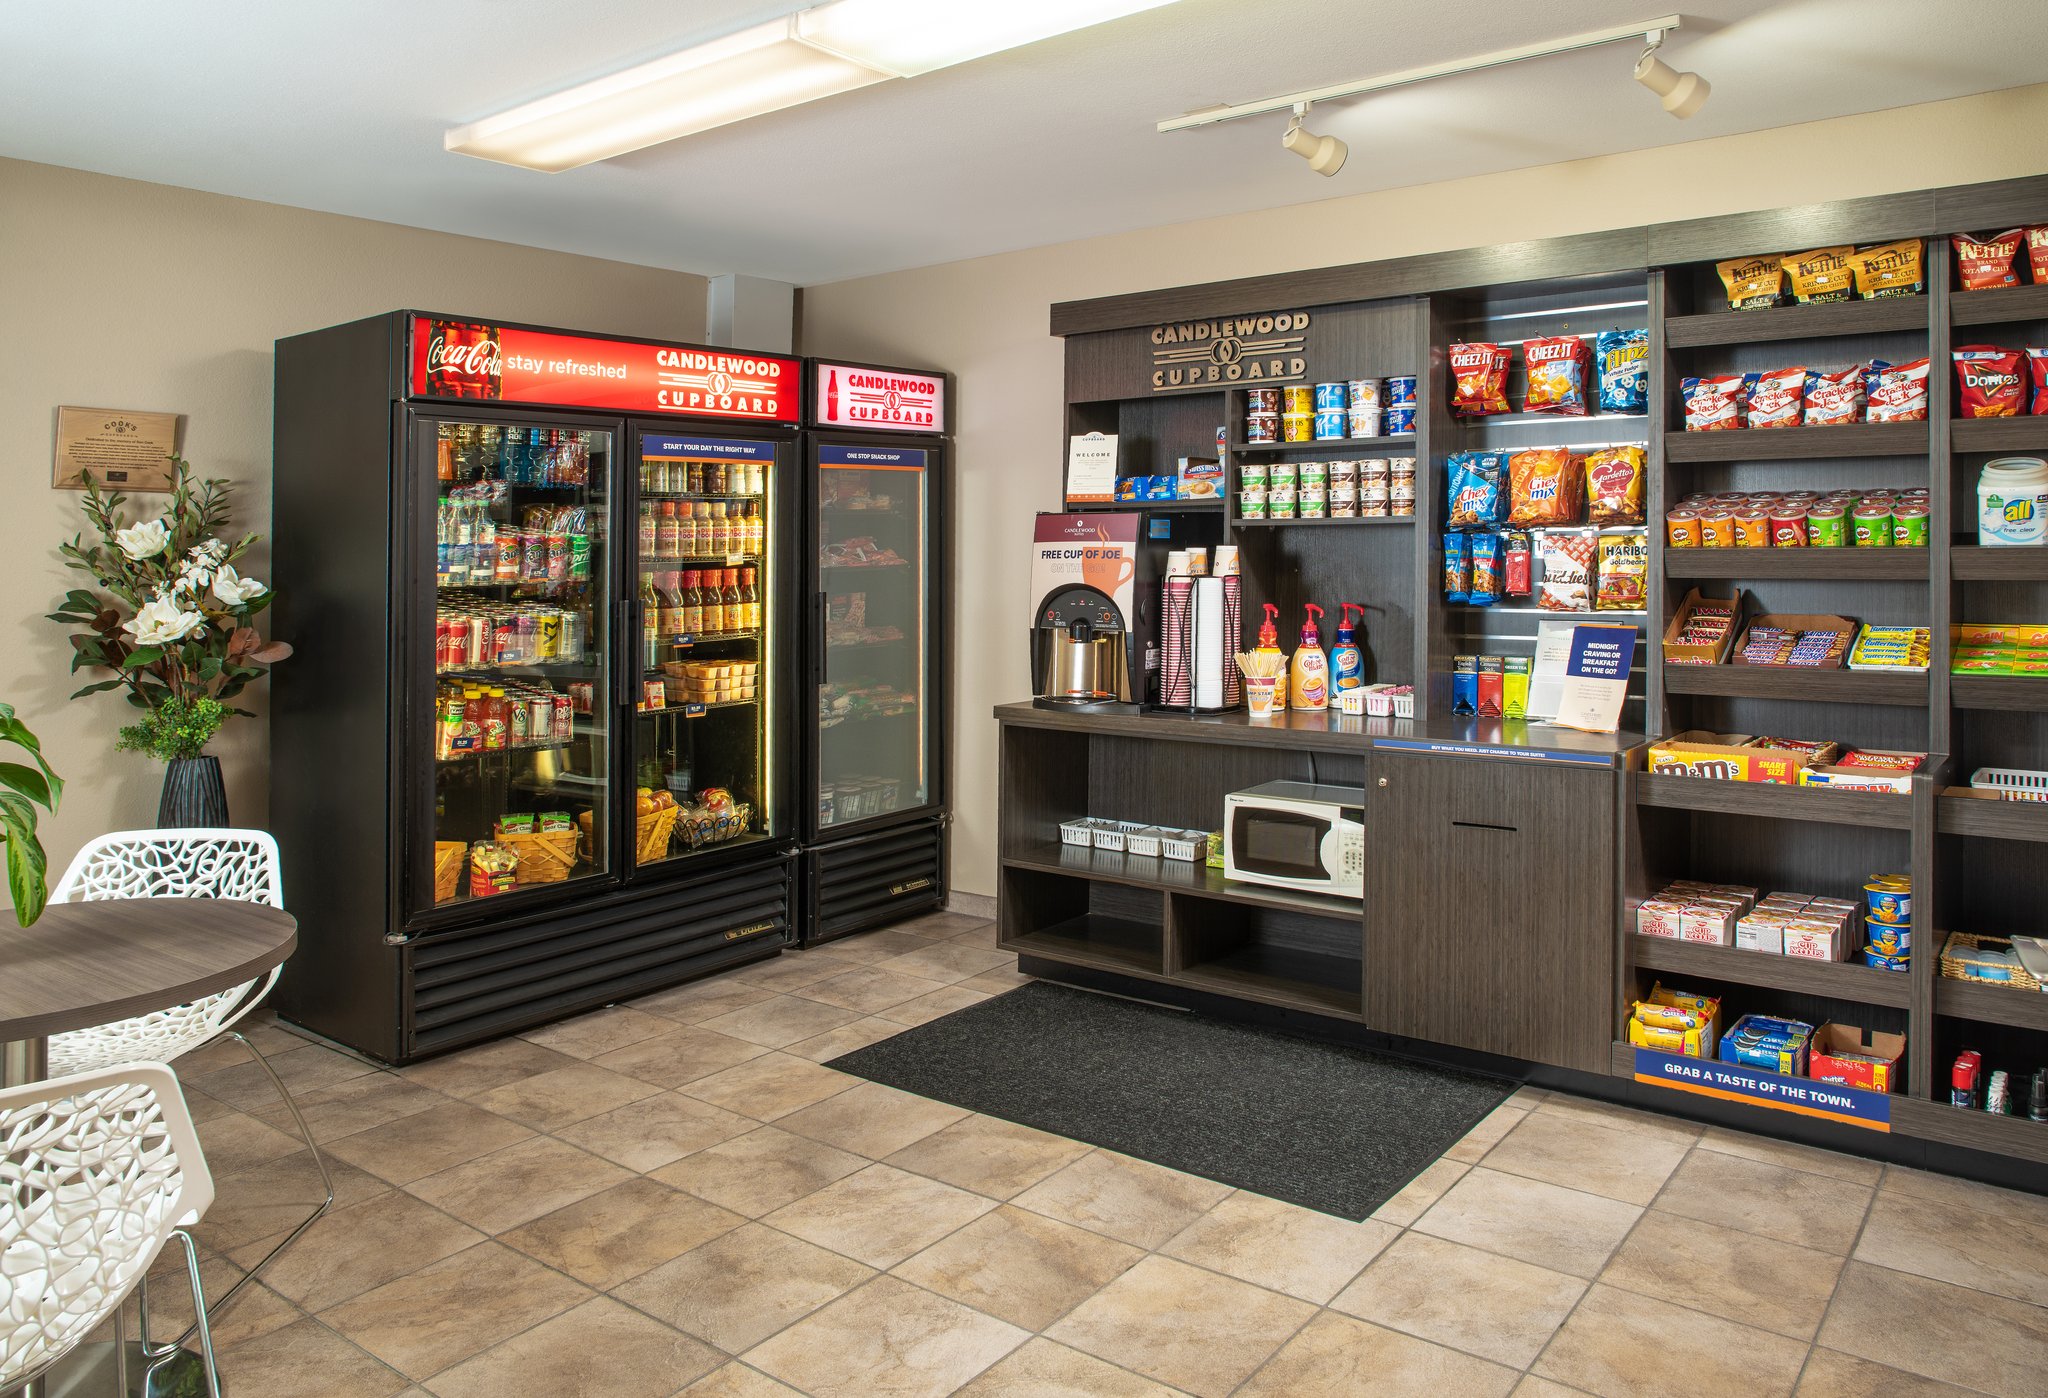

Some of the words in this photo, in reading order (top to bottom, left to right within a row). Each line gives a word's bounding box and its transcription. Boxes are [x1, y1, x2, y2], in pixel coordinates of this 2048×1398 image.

[1960, 241, 2015, 260] KETTLE
[1798, 253, 1848, 277] KETTLE
[1863, 250, 1916, 274] KETTLE
[1732, 260, 1780, 283] KETTLE
[1901, 269, 1915, 278] CUT
[1764, 279, 1777, 287] CUT
[1834, 274, 1849, 283] CUT
[1872, 280, 1893, 288] POTATO
[1806, 285, 1826, 293] POTATO
[1827, 281, 1845, 289] CHIPS
[1881, 289, 1901, 297] SALT
[1151, 312, 1310, 345] CANDLEWOOD
[427, 335, 503, 377] Coca-Cola
[1606, 345, 1648, 372] Flipz
[507, 355, 543, 374] stay
[549, 359, 627, 379] refreshed
[656, 350, 781, 378] CANDLEWOOD
[1609, 368, 1624, 377] White
[1624, 364, 1639, 375] Fudge
[1152, 358, 1306, 386] CUPBOARD
[848, 374, 935, 395] CANDLEWOOD
[1965, 374, 2019, 388] Doritos
[1813, 383, 1856, 400] Cracker
[1877, 379, 1921, 398] Cracker
[657, 389, 778, 413] CUPBOARD
[1690, 392, 1727, 408] Cracker
[1695, 401, 1719, 415] Jack
[1824, 407, 1849, 420] Original
[1888, 404, 1914, 416] Original
[849, 406, 933, 424] CUPBOARD
[1699, 414, 1721, 426] Original
[1759, 410, 1784, 422] Original
[104, 421, 137, 432] COOK'S
[684, 443, 699, 451] YOUR
[1590, 464, 1634, 491] Gardetto's
[1460, 486, 1490, 503] Chex
[1530, 487, 1556, 501] mix
[1462, 498, 1487, 512] mix
[2004, 499, 2032, 522] all
[1041, 550, 1061, 560] FREE
[1063, 549, 1083, 559] CUP
[1085, 550, 1099, 559] OF
[1101, 550, 1120, 559] JOE
[1587, 642, 1619, 650] MIDNIGHT
[1865, 640, 1908, 648] Butterfinger
[1583, 650, 1611, 658] CRAVING
[1304, 659, 1322, 668] Coffee
[1582, 658, 1619, 666] BREAKFAST
[512, 708, 527, 722] V8
[1758, 761, 1787, 769] SHARE
[1766, 768, 1786, 776] SIZE
[1650, 920, 1668, 928] CUP
[1693, 926, 1711, 934] CUP
[1642, 926, 1674, 936] NOODLES
[1685, 931, 1717, 942] NOODLES
[1797, 941, 1818, 950] CUP
[1790, 948, 1825, 959] NOODLES
[1665, 1063, 1700, 1078] GRAB
[1703, 1070, 1713, 1080] A
[1716, 1072, 1756, 1089] TASTE
[1759, 1081, 1778, 1092] OF
[1780, 1085, 1806, 1099] THE
[1809, 1091, 1856, 1109] TOWN.
